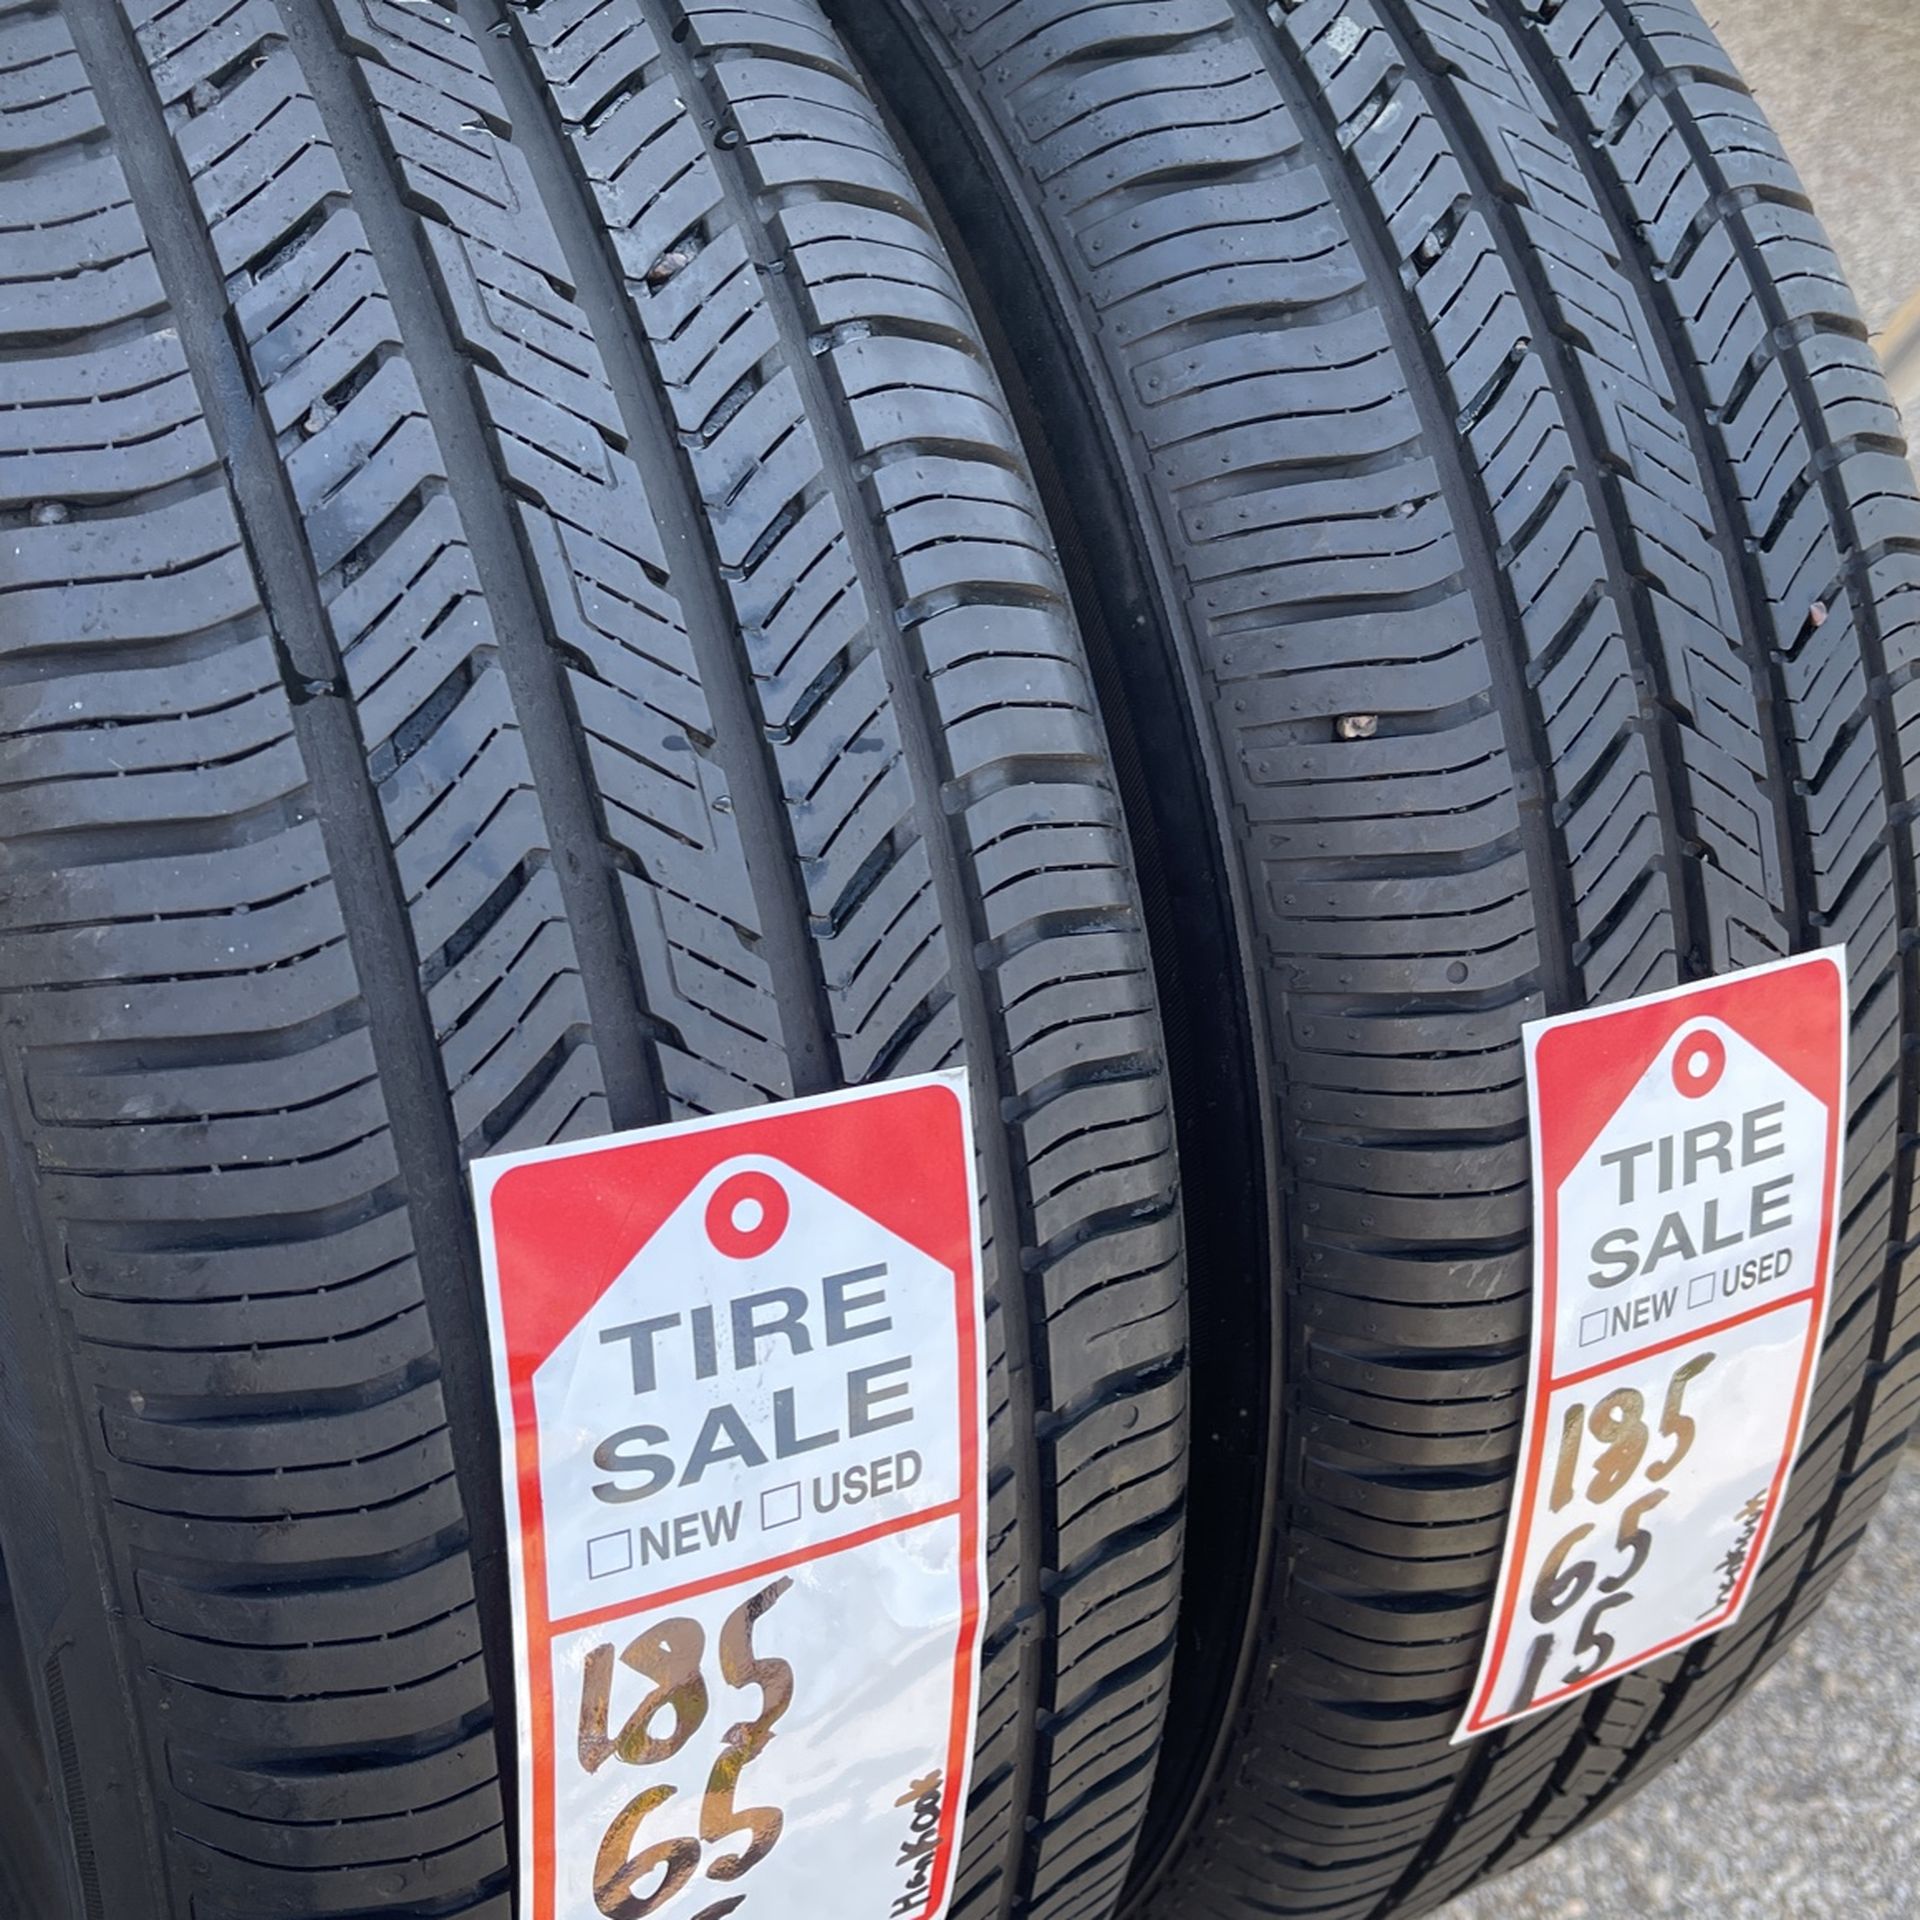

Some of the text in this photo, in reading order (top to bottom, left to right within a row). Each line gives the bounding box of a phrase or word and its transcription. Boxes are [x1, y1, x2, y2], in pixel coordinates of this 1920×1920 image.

[1600, 1100, 1785, 1206] TIRE
[1587, 1173, 1794, 1290] SALE
[1611, 1248, 1793, 1336] NEW USED
[599, 1262, 893, 1395] TIRE
[591, 1355, 914, 1505] SALE
[1549, 1352, 1716, 1514] 185
[640, 1449, 923, 1566] NEW USED
[1530, 1488, 1670, 1624] 65
[577, 1575, 794, 1775] 185
[1508, 1591, 1634, 1715] 15
[593, 1746, 784, 1920] 65
